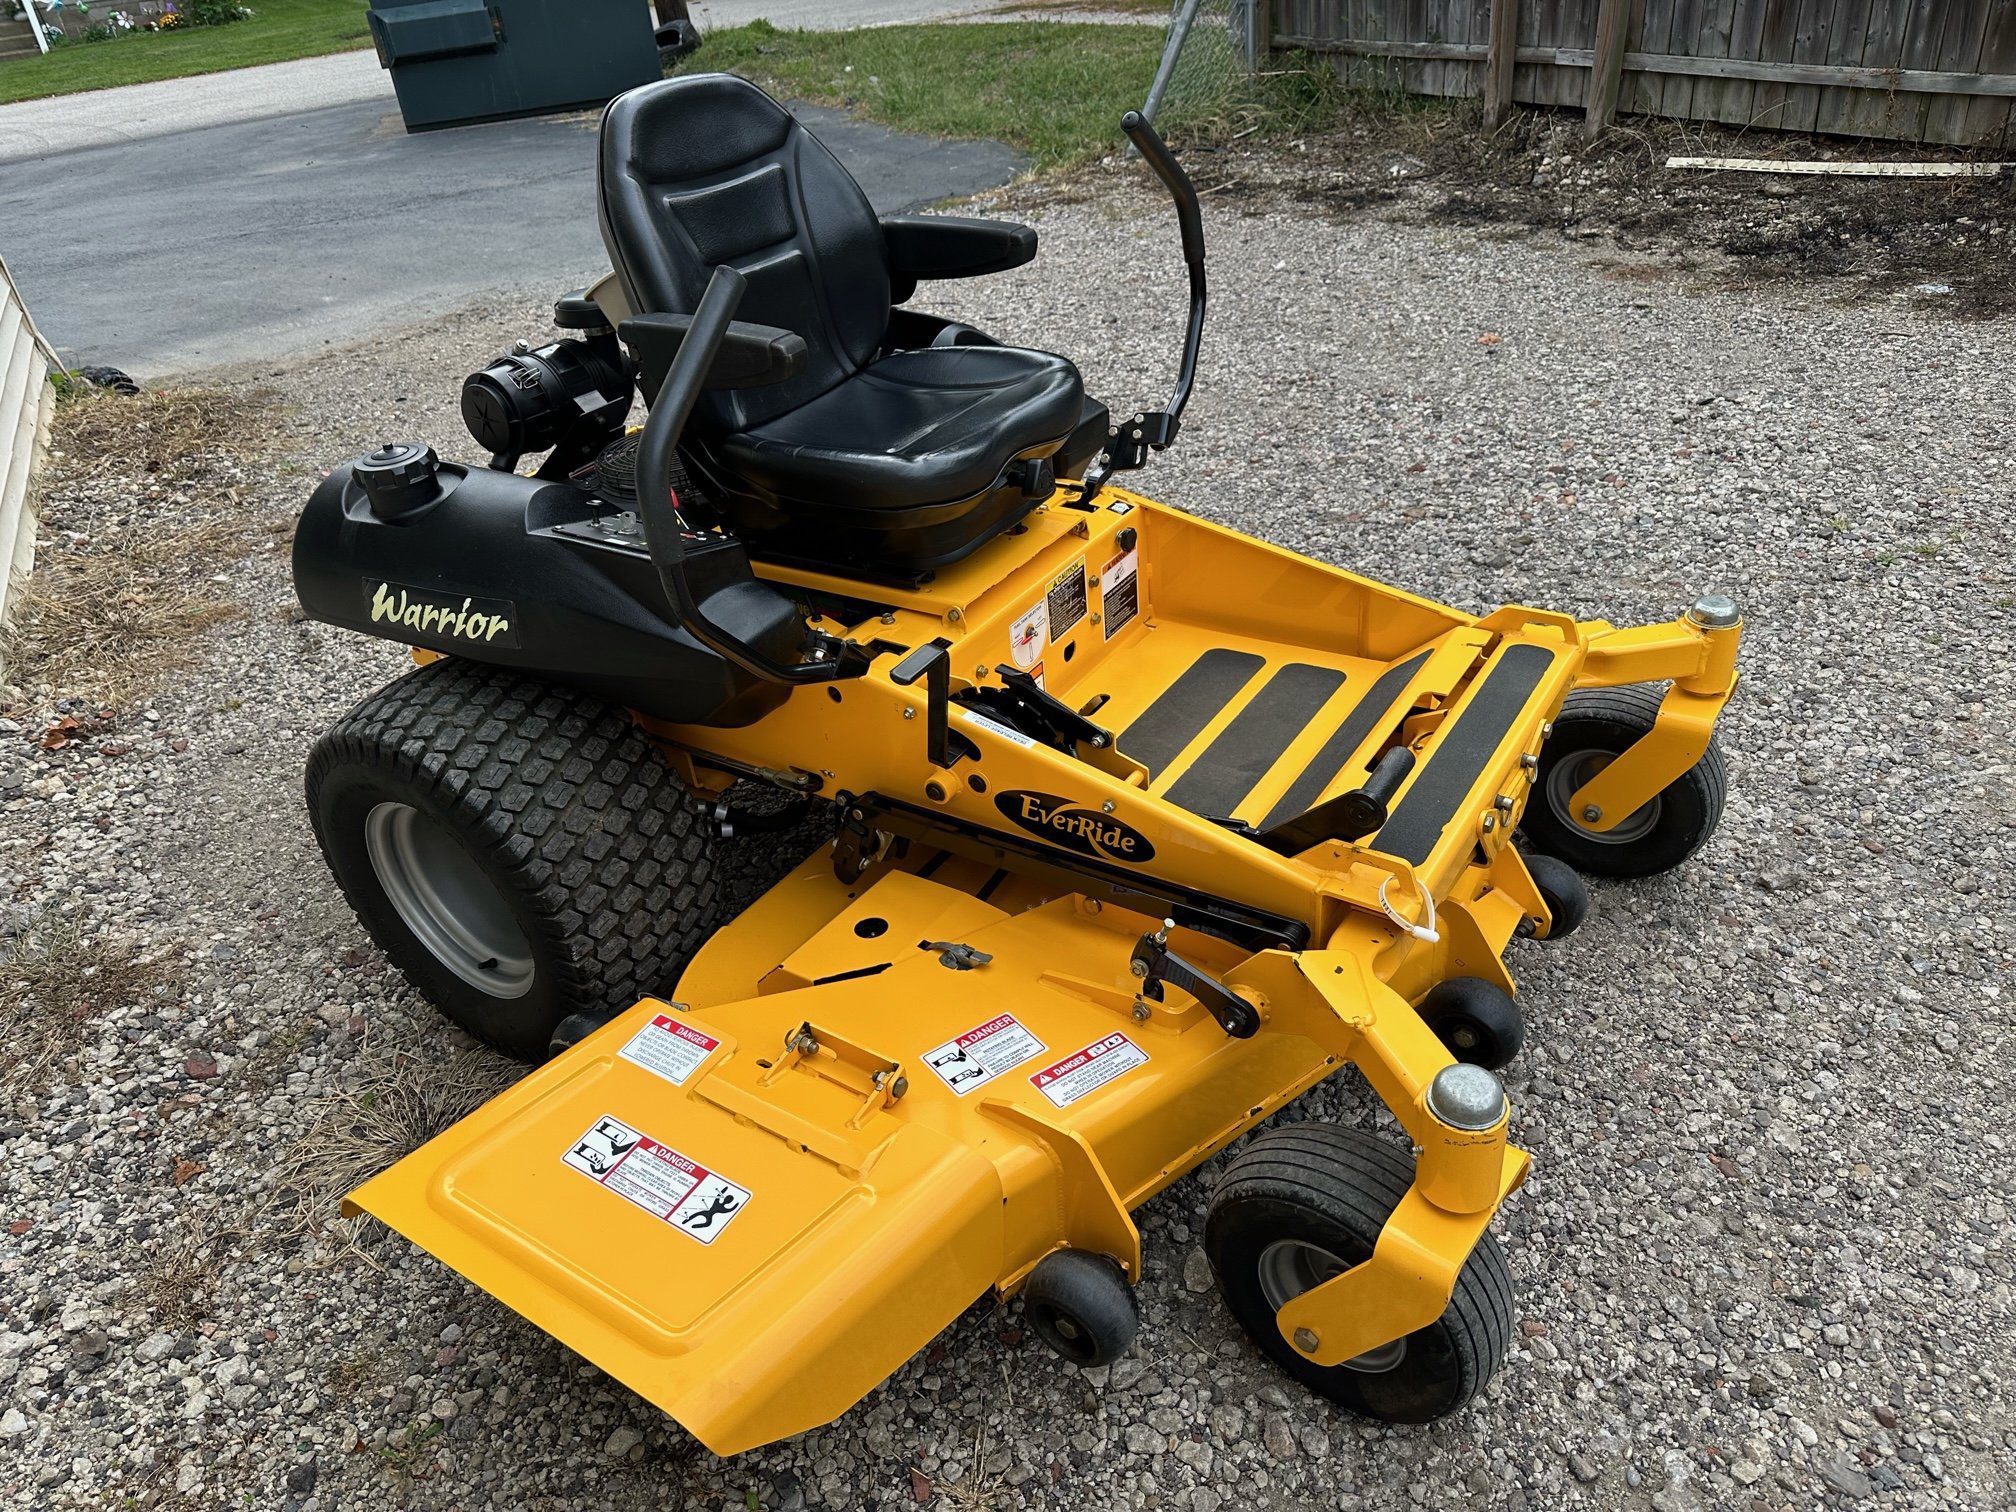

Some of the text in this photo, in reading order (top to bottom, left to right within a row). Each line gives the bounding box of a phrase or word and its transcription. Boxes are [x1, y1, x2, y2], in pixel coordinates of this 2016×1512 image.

[1057, 561, 1079, 583] CAUTION
[371, 583, 508, 641] Warrior
[1020, 793, 1137, 856] EverRide
[676, 1027, 710, 1046] DANGER
[968, 1016, 1014, 1042] DANGER
[1053, 1055, 1088, 1076] DANGER
[1076, 1069, 1091, 1078] STAND
[1090, 1063, 1103, 1071] NEAR
[1102, 1054, 1121, 1064] MACHINE
[1079, 1076, 1098, 1087] OPERATE
[1098, 1067, 1115, 1077] MOWER
[1114, 1057, 1133, 1068] WITHOUT
[657, 1148, 696, 1173] DANGER
